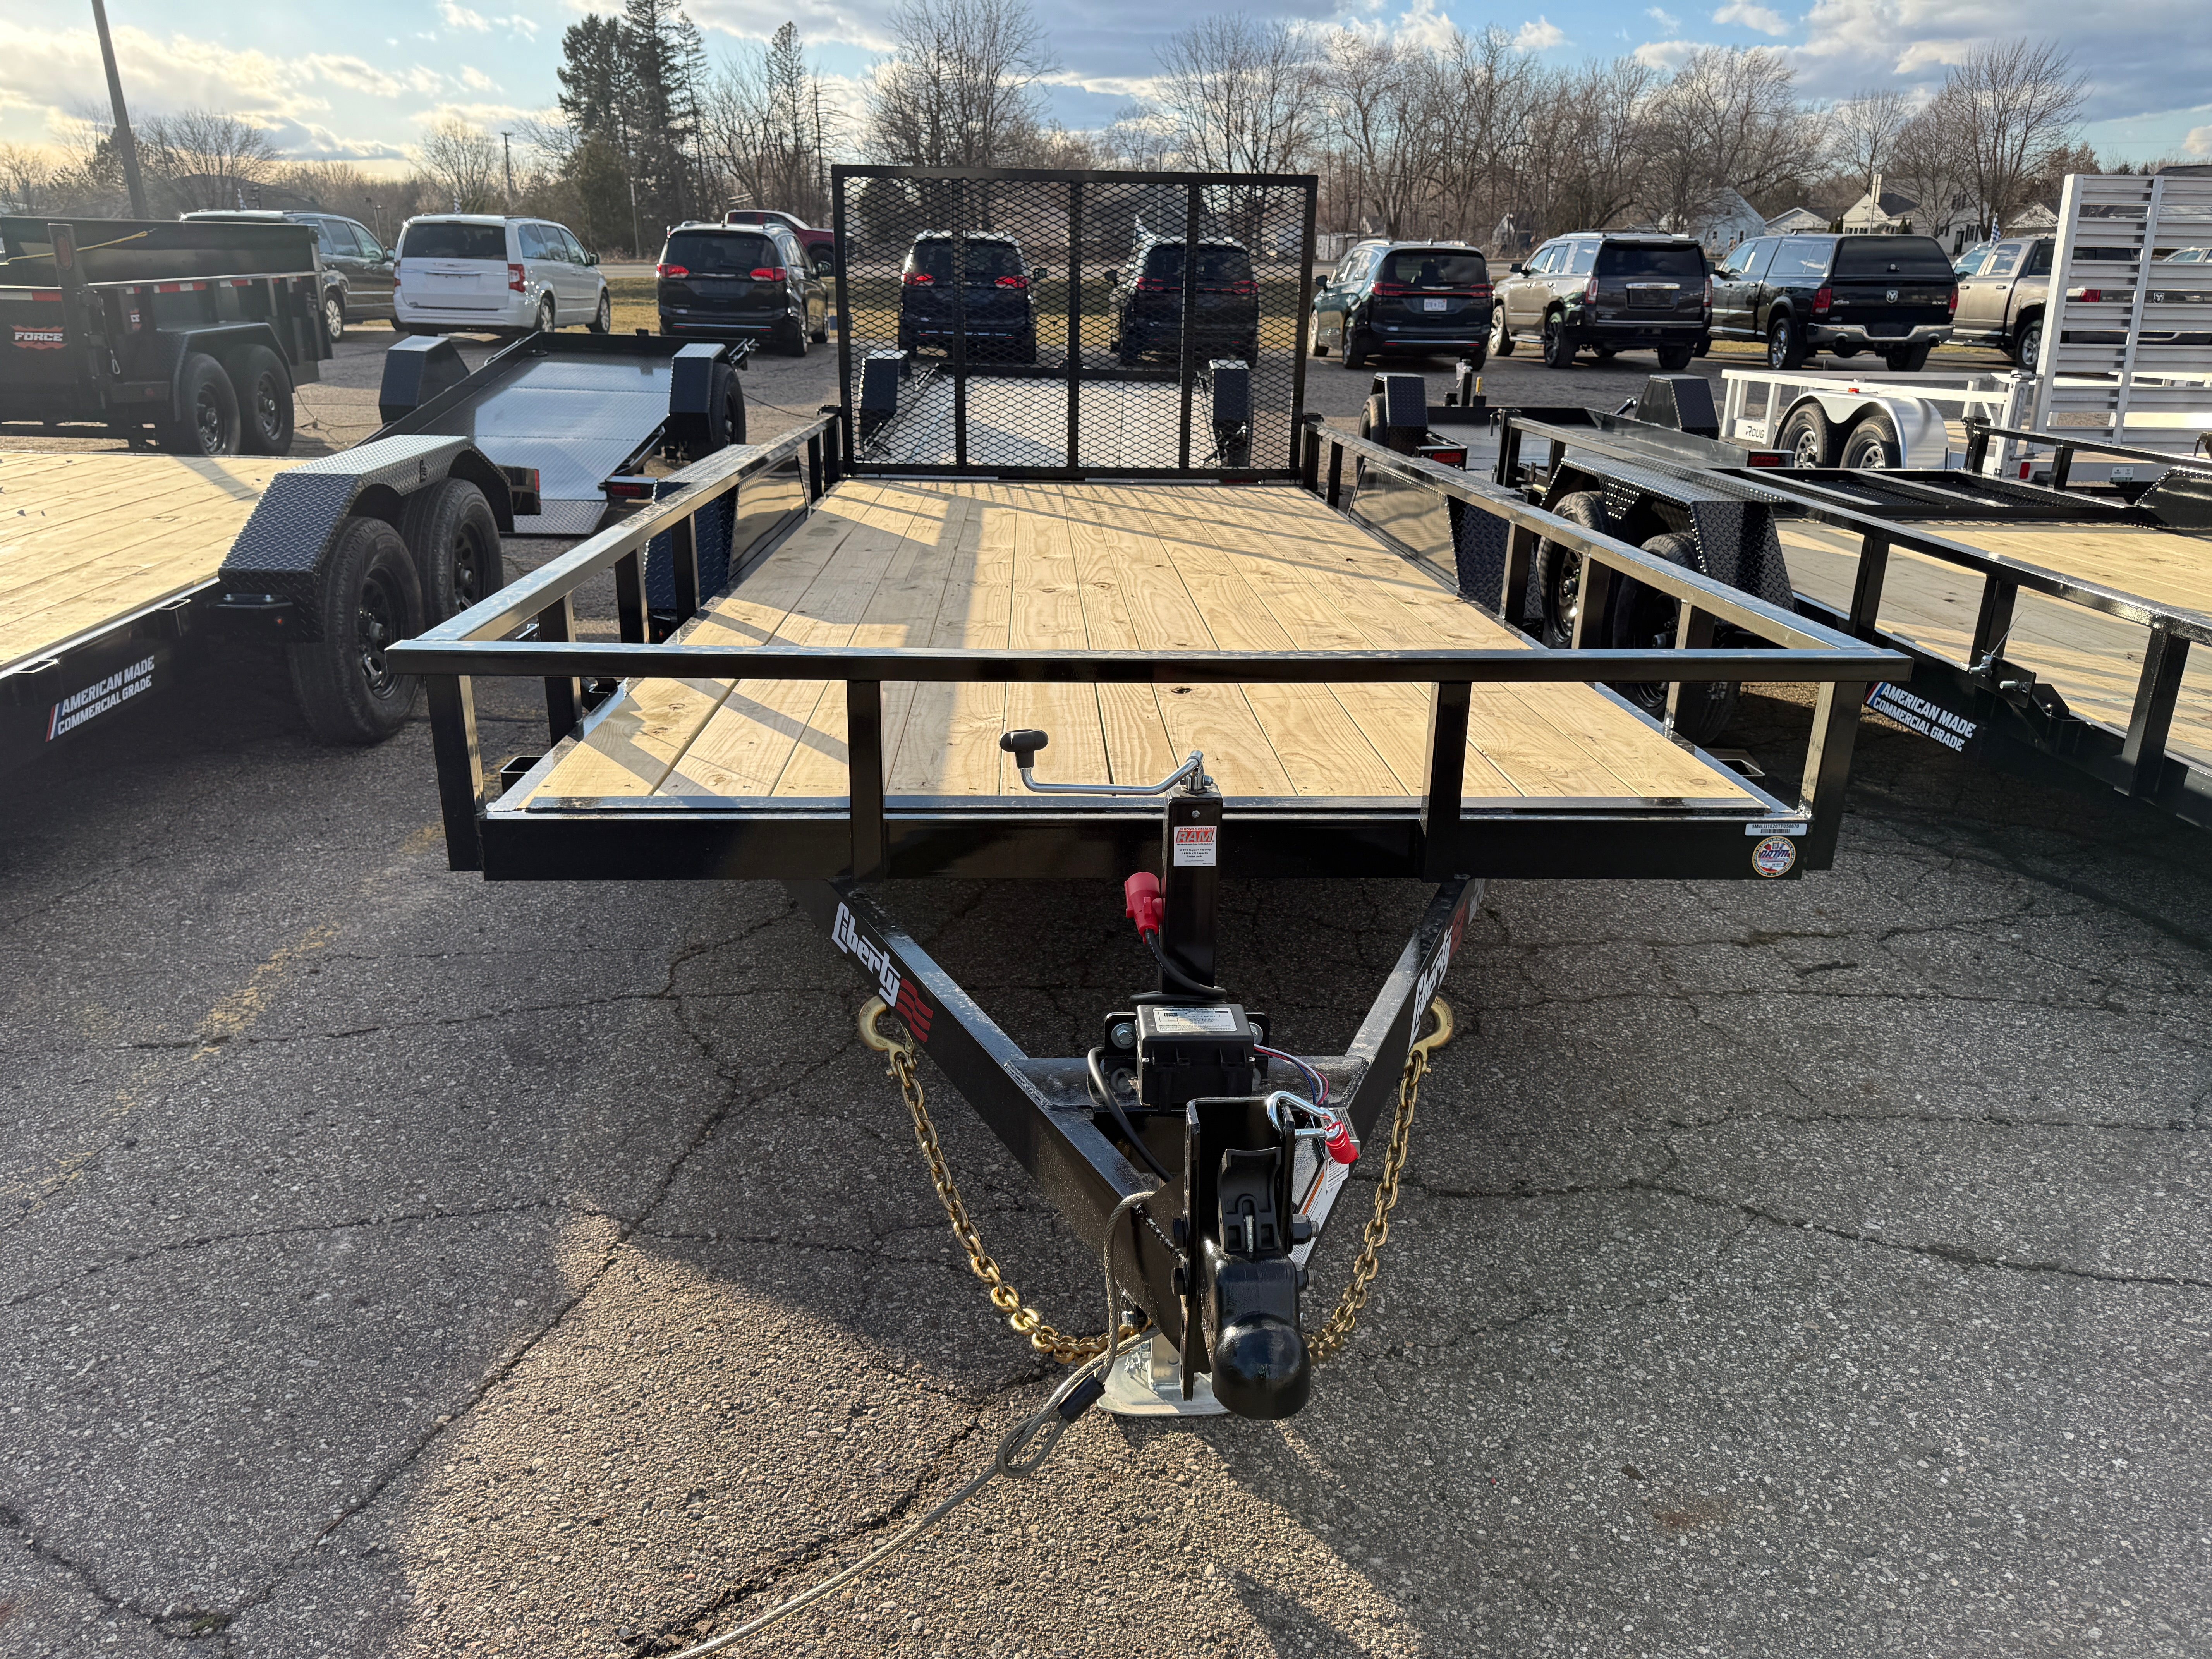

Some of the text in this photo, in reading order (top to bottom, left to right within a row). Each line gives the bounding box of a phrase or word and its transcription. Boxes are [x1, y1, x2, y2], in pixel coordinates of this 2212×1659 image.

[15, 332, 63, 341] FORCE
[58, 674, 151, 735] COMMERCIAL GRADE
[61, 655, 154, 716] AMERICAN MADE
[1881, 683, 1977, 738] AMERICAN MADE
[1873, 697, 1965, 752] COMMERCIAL GRADE
[1177, 831, 1213, 842] RAM
[831, 902, 900, 1007] Liberty
[1407, 926, 1453, 1054] Liberty
